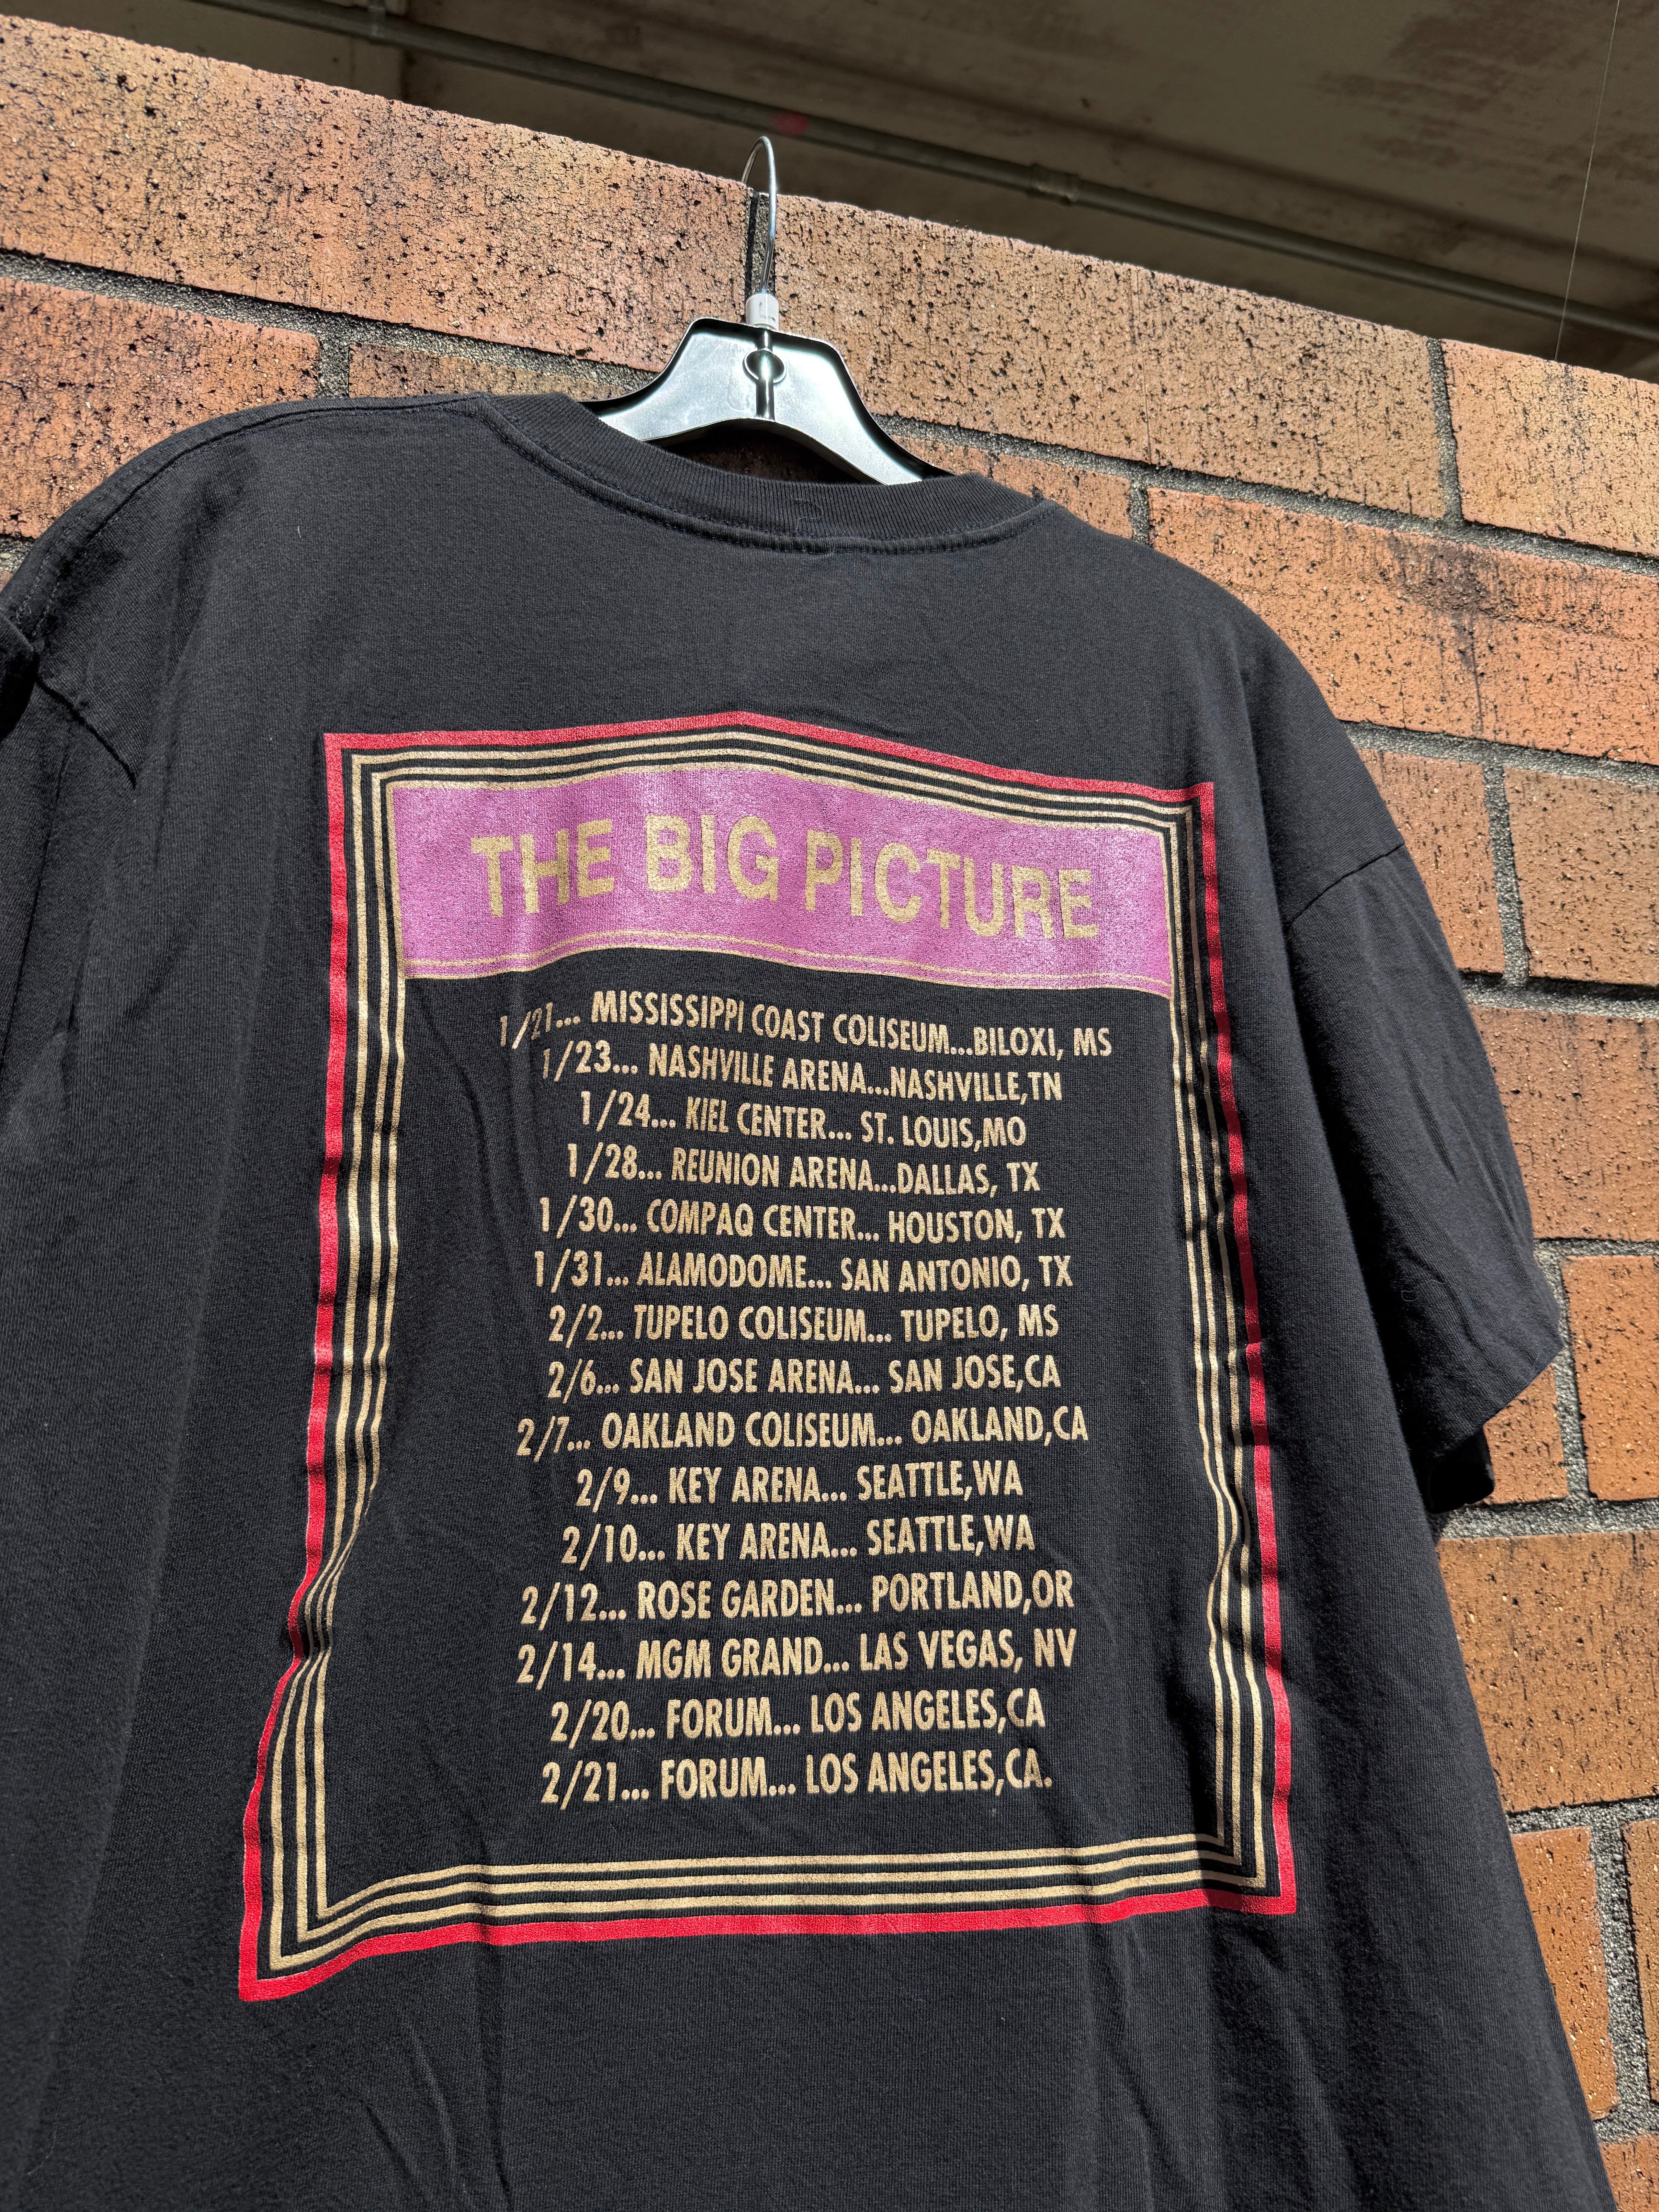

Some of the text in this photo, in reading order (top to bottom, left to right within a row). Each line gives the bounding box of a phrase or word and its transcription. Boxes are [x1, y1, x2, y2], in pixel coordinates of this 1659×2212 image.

[469, 812, 1100, 942] THE BIG PICTURE
[591, 990, 744, 1032] MISSISSIPPI
[752, 1004, 824, 1042] COAST
[1073, 1028, 1112, 1056] MS
[649, 1043, 774, 1087] NASHVILLE
[686, 1097, 728, 1132] KIEL
[861, 1111, 894, 1144] ST.
[672, 1147, 779, 1187] REUNION
[1006, 1162, 1040, 1192] TX
[647, 1199, 754, 1237] COMPAQ
[889, 1209, 1022, 1243] HOUSTON,
[1031, 1207, 1065, 1238] TX
[841, 1258, 889, 1292] SAN
[899, 1255, 1029, 1292] ANTONIO,
[1038, 1255, 1073, 1286] TX
[634, 1305, 728, 1340] TUPELO
[901, 1305, 1008, 1341] TUPELO,
[1018, 1304, 1059, 1337] MS
[630, 1358, 683, 1393] SAN
[693, 1358, 757, 1393] JOSE
[889, 1358, 942, 1393] SAN
[602, 1412, 735, 1448] OAKLAND
[669, 1467, 721, 1503] KEY
[677, 1523, 730, 1560] KEY
[638, 1580, 711, 1620] ROSE
[636, 1639, 711, 1679] MGM
[860, 1632, 908, 1671] LAS
[918, 1629, 1022, 1673] VEGAS,
[1034, 1628, 1076, 1667] NV
[811, 1692, 862, 1733] LOS
[806, 1753, 858, 1794] LOS
